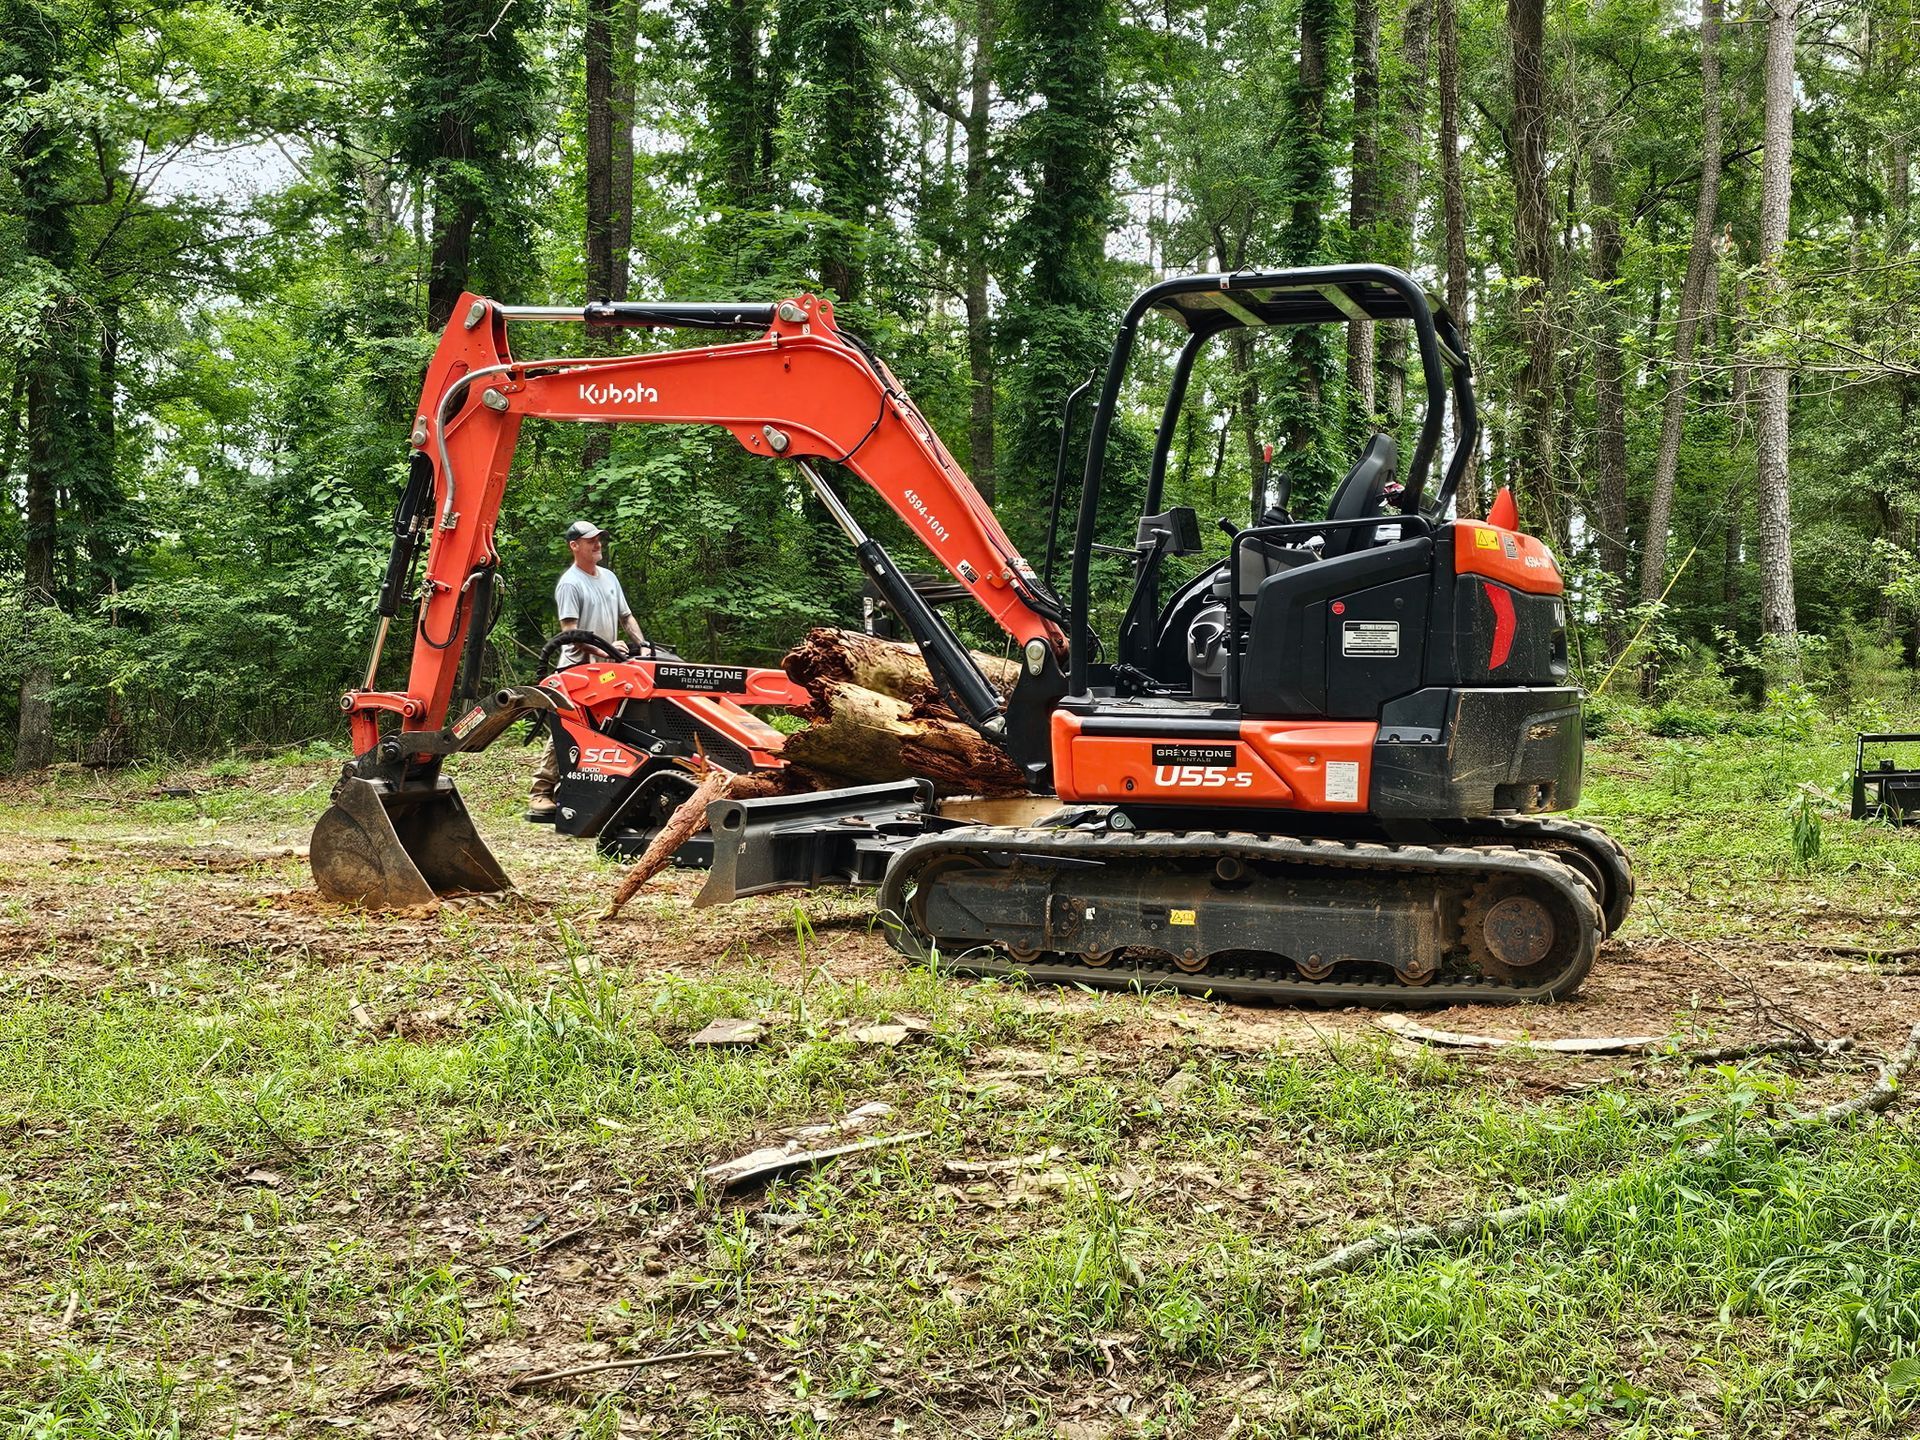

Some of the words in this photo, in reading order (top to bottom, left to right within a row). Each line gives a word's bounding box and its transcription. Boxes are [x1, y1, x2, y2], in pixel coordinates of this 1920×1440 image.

[579, 382, 658, 404] Kubota
[904, 489, 950, 542] 4594-1001
[660, 667, 743, 680] GREYSTONE
[582, 748, 627, 764] SCL
[1156, 748, 1232, 758] GREYSTONE
[566, 771, 608, 783] 4651-1002
